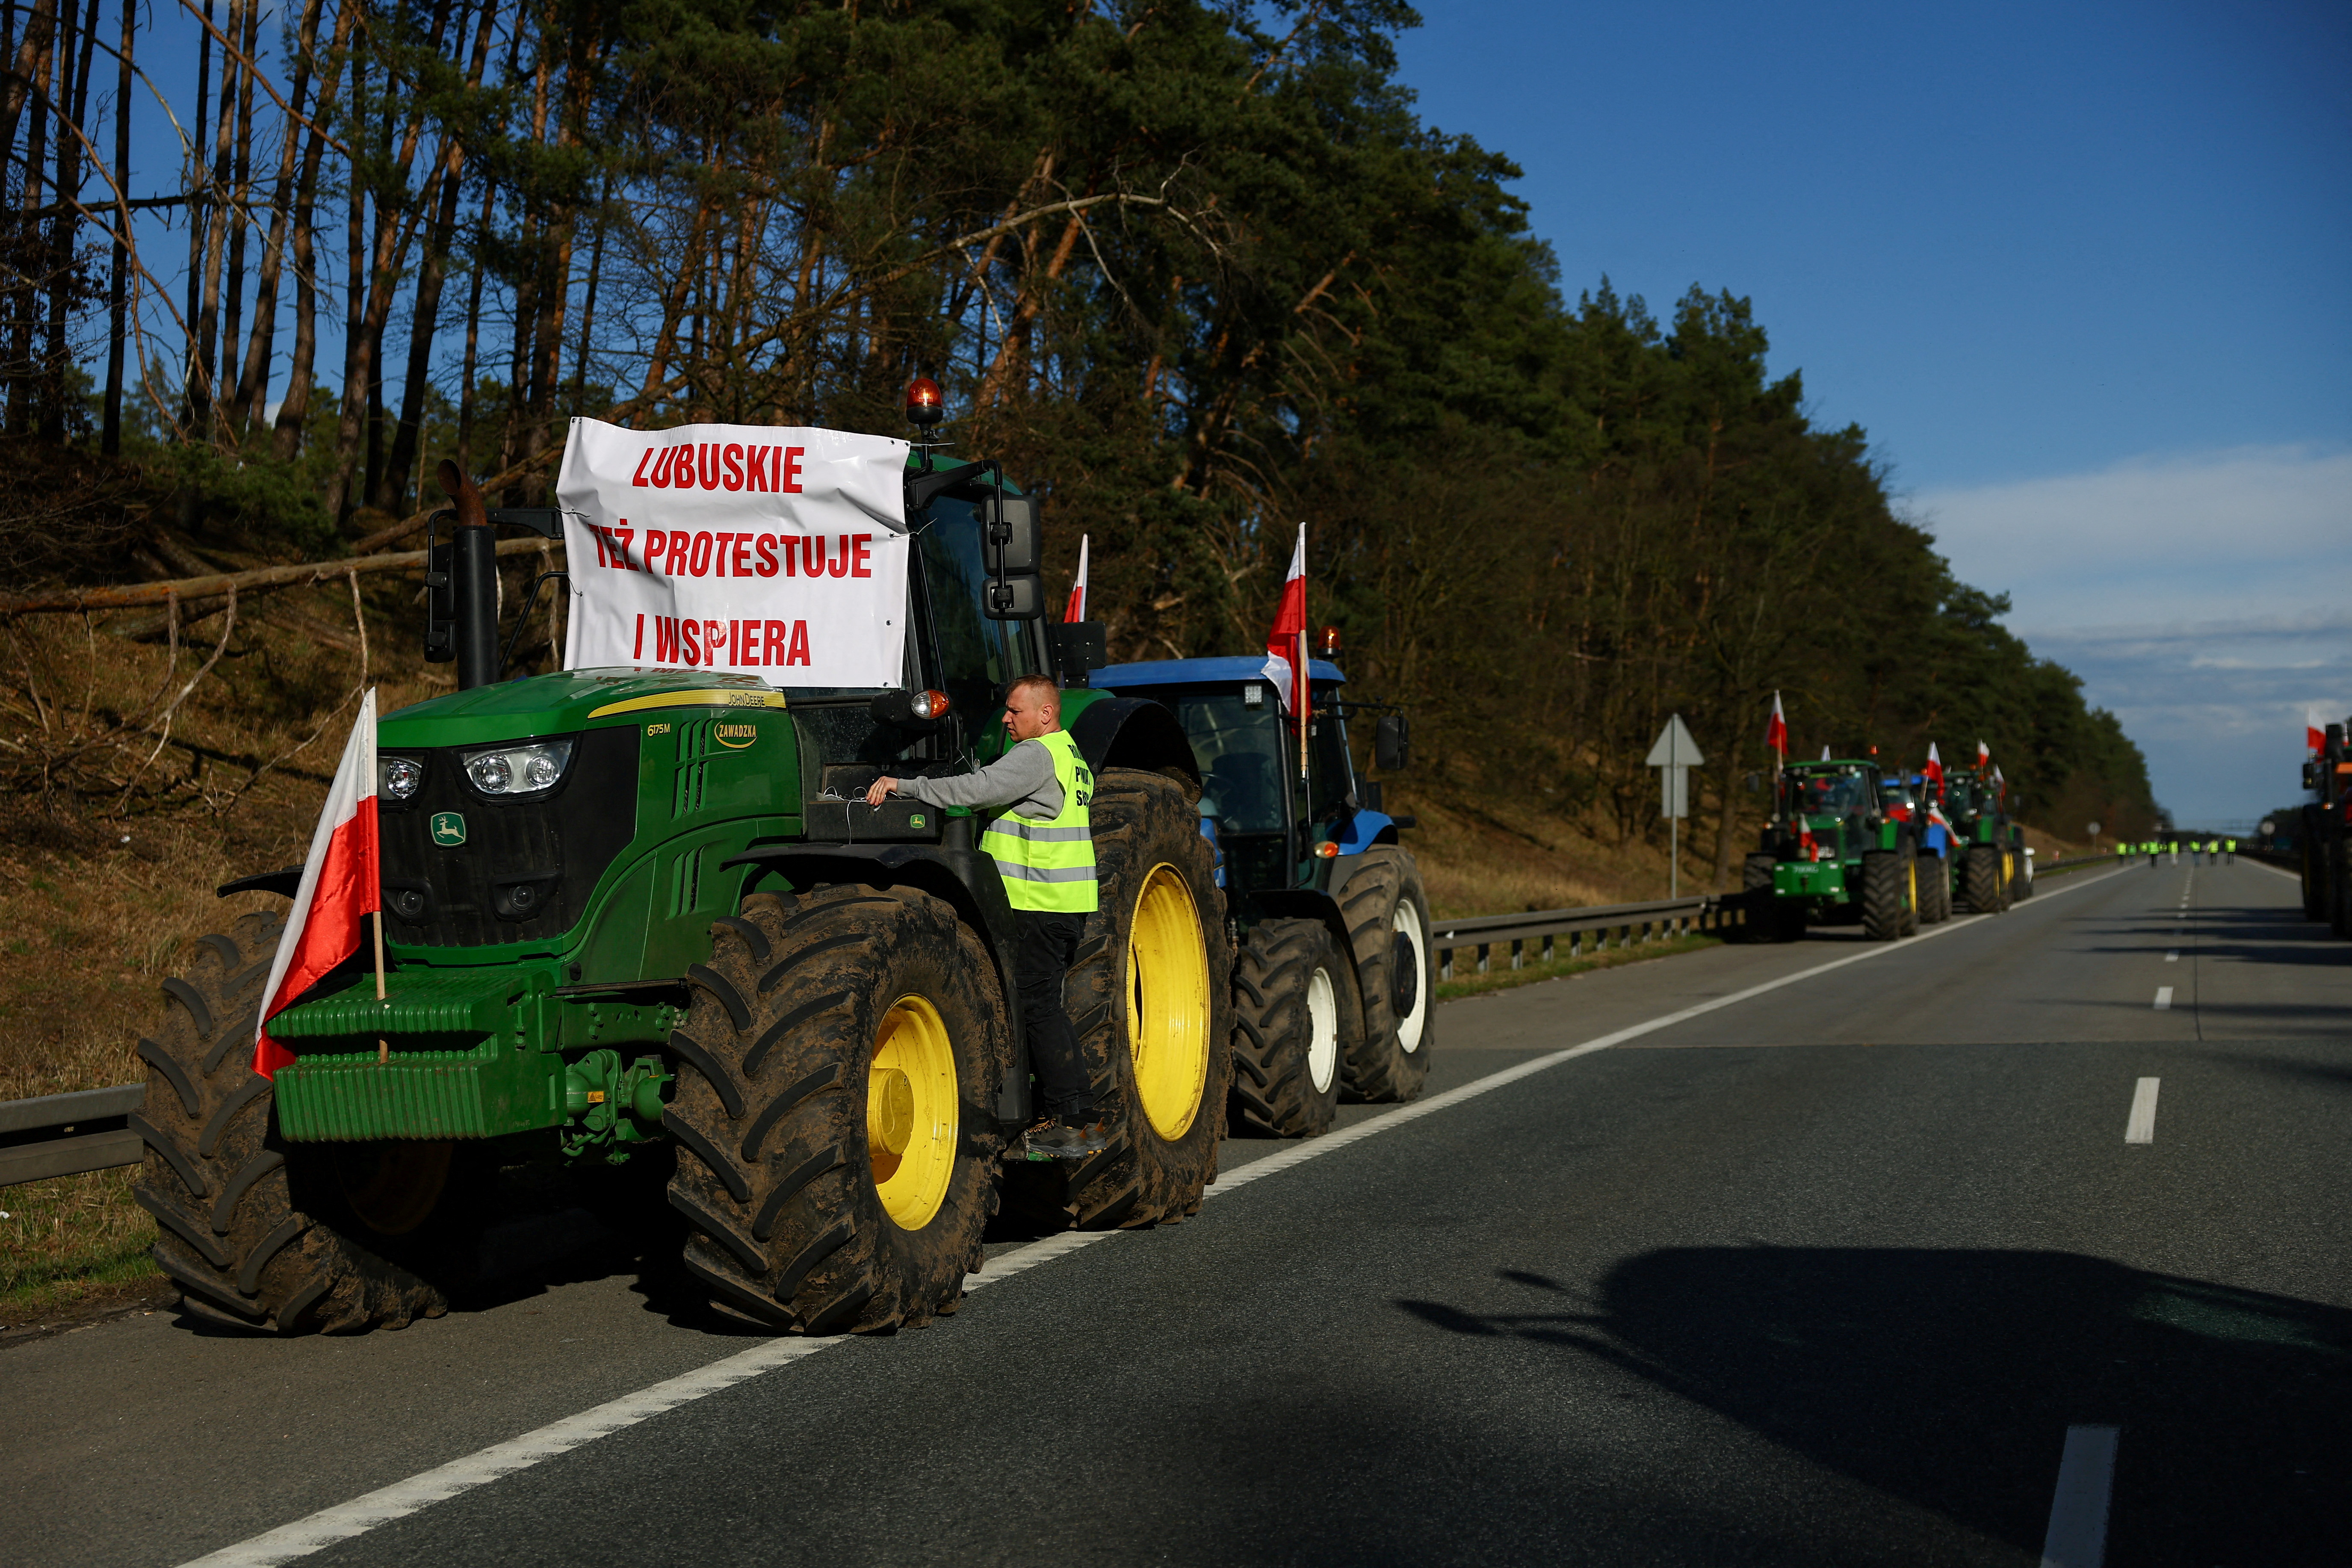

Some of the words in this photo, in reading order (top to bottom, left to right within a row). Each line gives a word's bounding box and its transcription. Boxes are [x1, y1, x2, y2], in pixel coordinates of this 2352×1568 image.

[632, 443, 805, 493] LUBUSKIE
[588, 519, 639, 571] TEŻ
[644, 529, 872, 578] PROTESTUJE
[633, 614, 644, 660] I
[656, 615, 811, 667] WSPIERA
[647, 723, 670, 737] 6175M
[719, 725, 756, 738] ZAWADZKA
